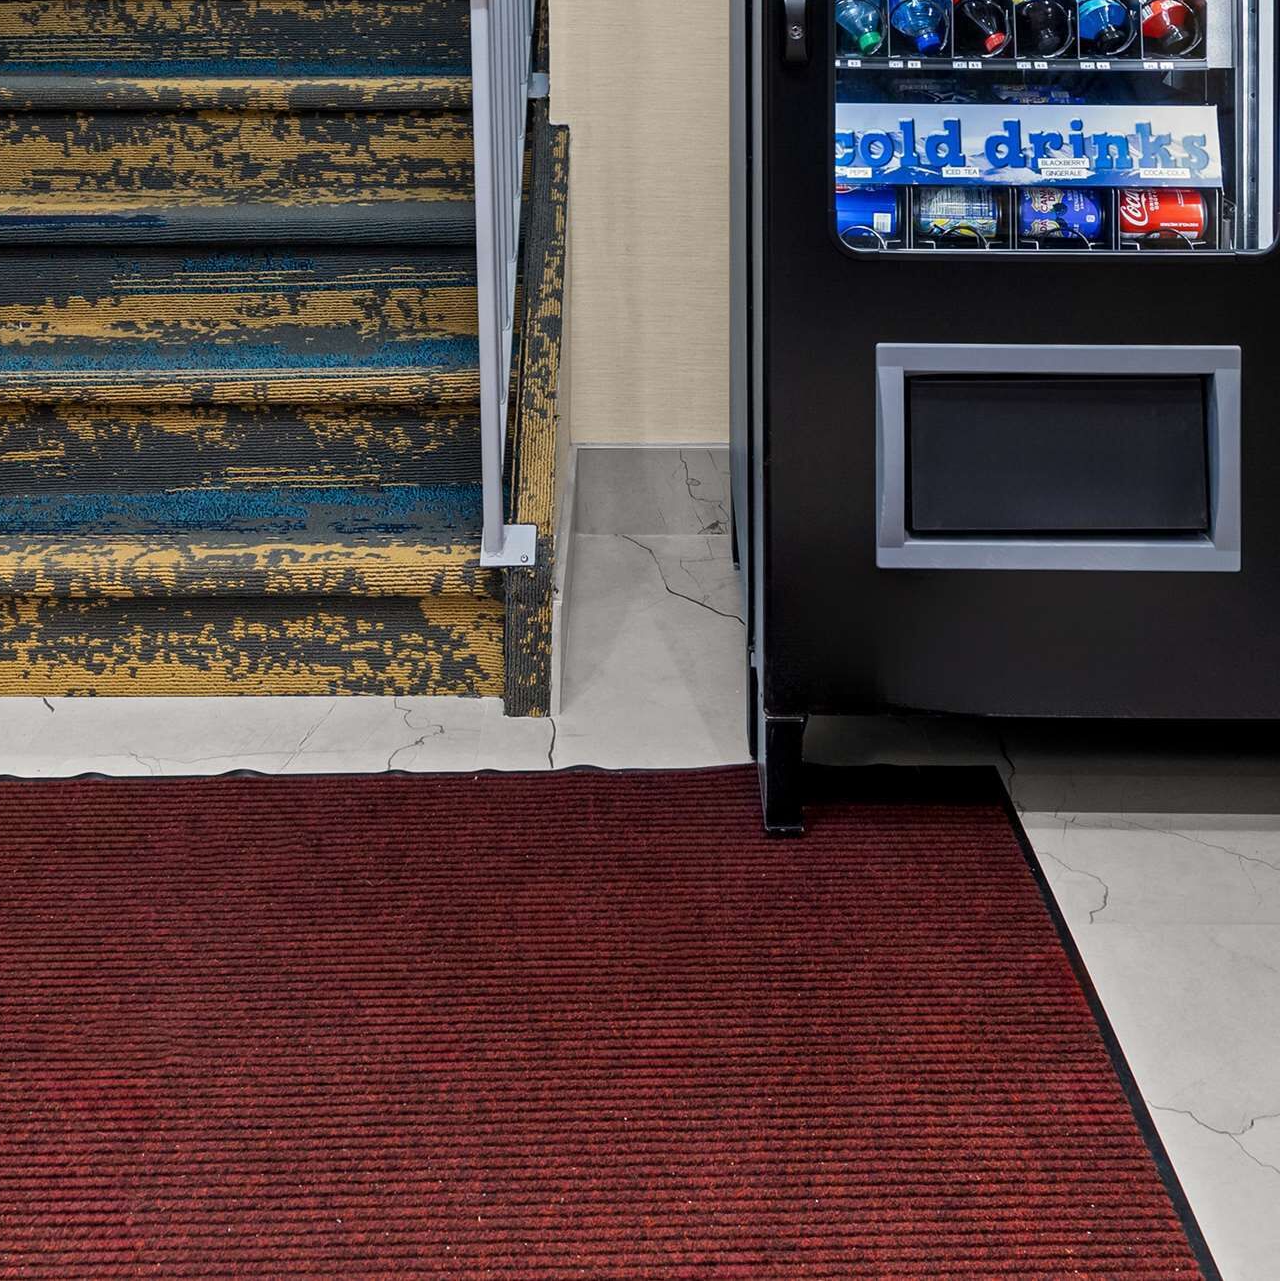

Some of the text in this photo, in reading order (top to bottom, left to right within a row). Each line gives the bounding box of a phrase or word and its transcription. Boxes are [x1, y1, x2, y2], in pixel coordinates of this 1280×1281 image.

[835, 118, 1210, 170] cold drinks
[1041, 159, 1086, 167] BLACKBERRY
[945, 168, 978, 176] ICED TEA
